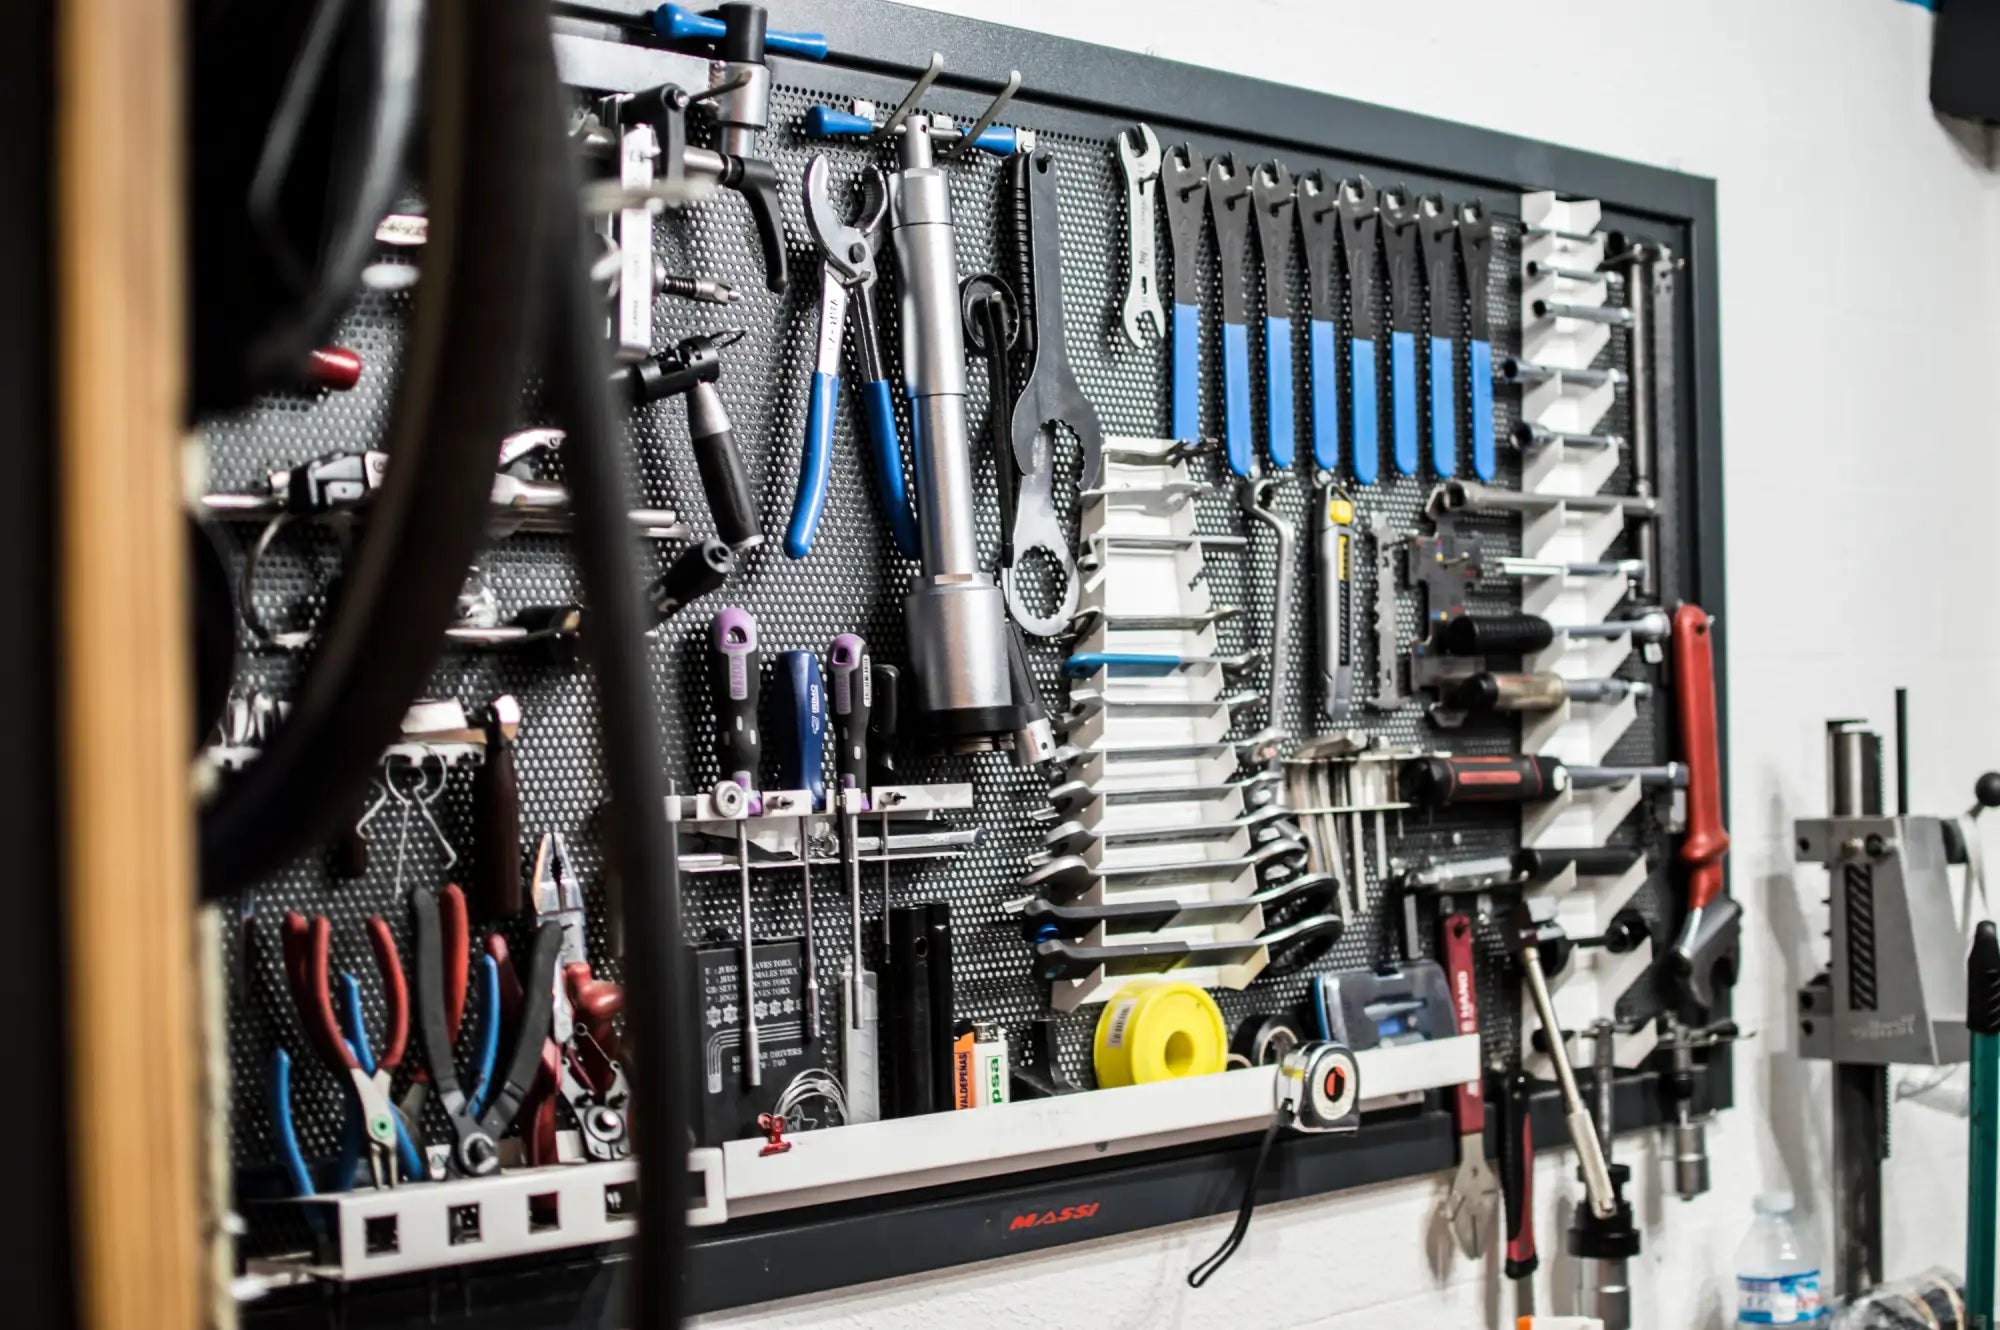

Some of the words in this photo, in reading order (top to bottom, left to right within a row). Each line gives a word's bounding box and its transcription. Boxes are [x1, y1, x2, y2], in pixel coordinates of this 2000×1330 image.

[810, 684, 820, 713] IRIMO
[773, 959, 792, 969] TORX
[779, 967, 798, 976] TORX
[773, 977, 791, 985] TORX
[773, 986, 791, 995] TORX
[769, 1047, 803, 1059] DRIVERS
[958, 1053, 968, 1109] VALDEPEÑAS
[990, 1058, 1002, 1103] psa
[1008, 1201, 1100, 1231] MASSI
